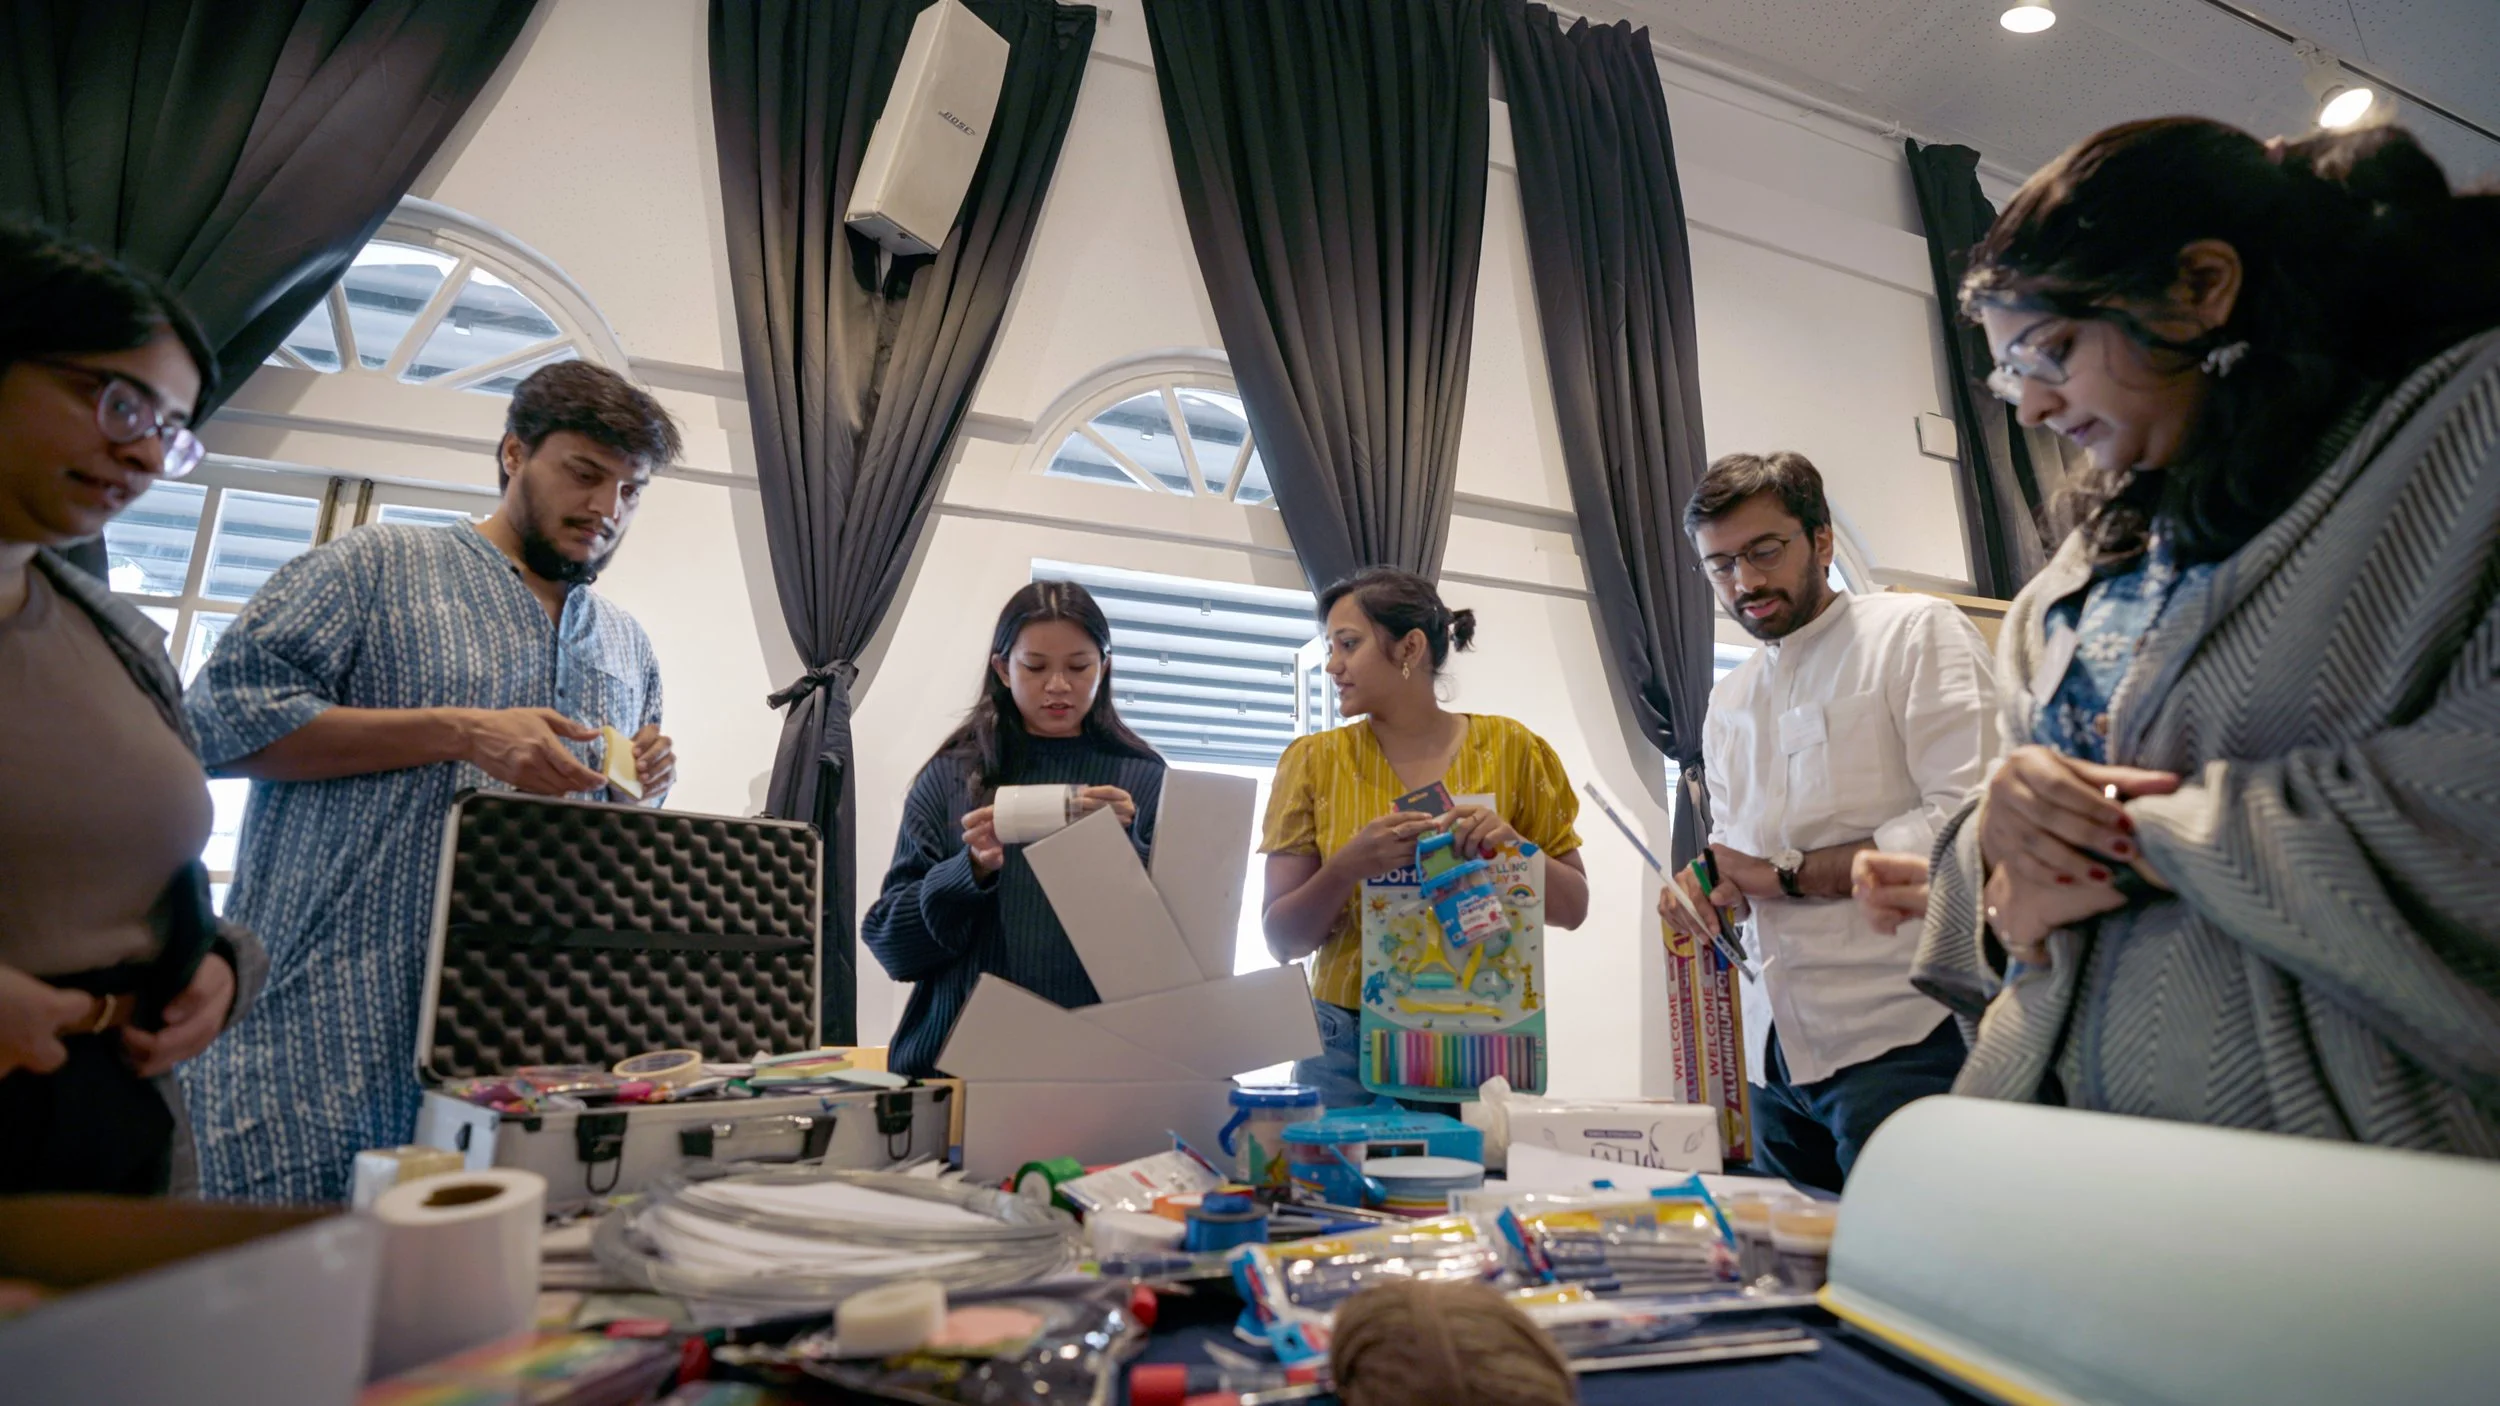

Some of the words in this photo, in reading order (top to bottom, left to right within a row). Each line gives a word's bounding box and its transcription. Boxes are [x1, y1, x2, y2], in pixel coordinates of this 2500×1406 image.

[938, 111, 975, 135] BOSE
[1716, 971, 1731, 1000] FOI
[1669, 993, 1683, 1081] WELCOME
[1681, 1001, 1699, 1102] ALUMINIUM
[1704, 987, 1719, 1076] WELCOME
[1718, 1001, 1738, 1105] ALUMINIUM
